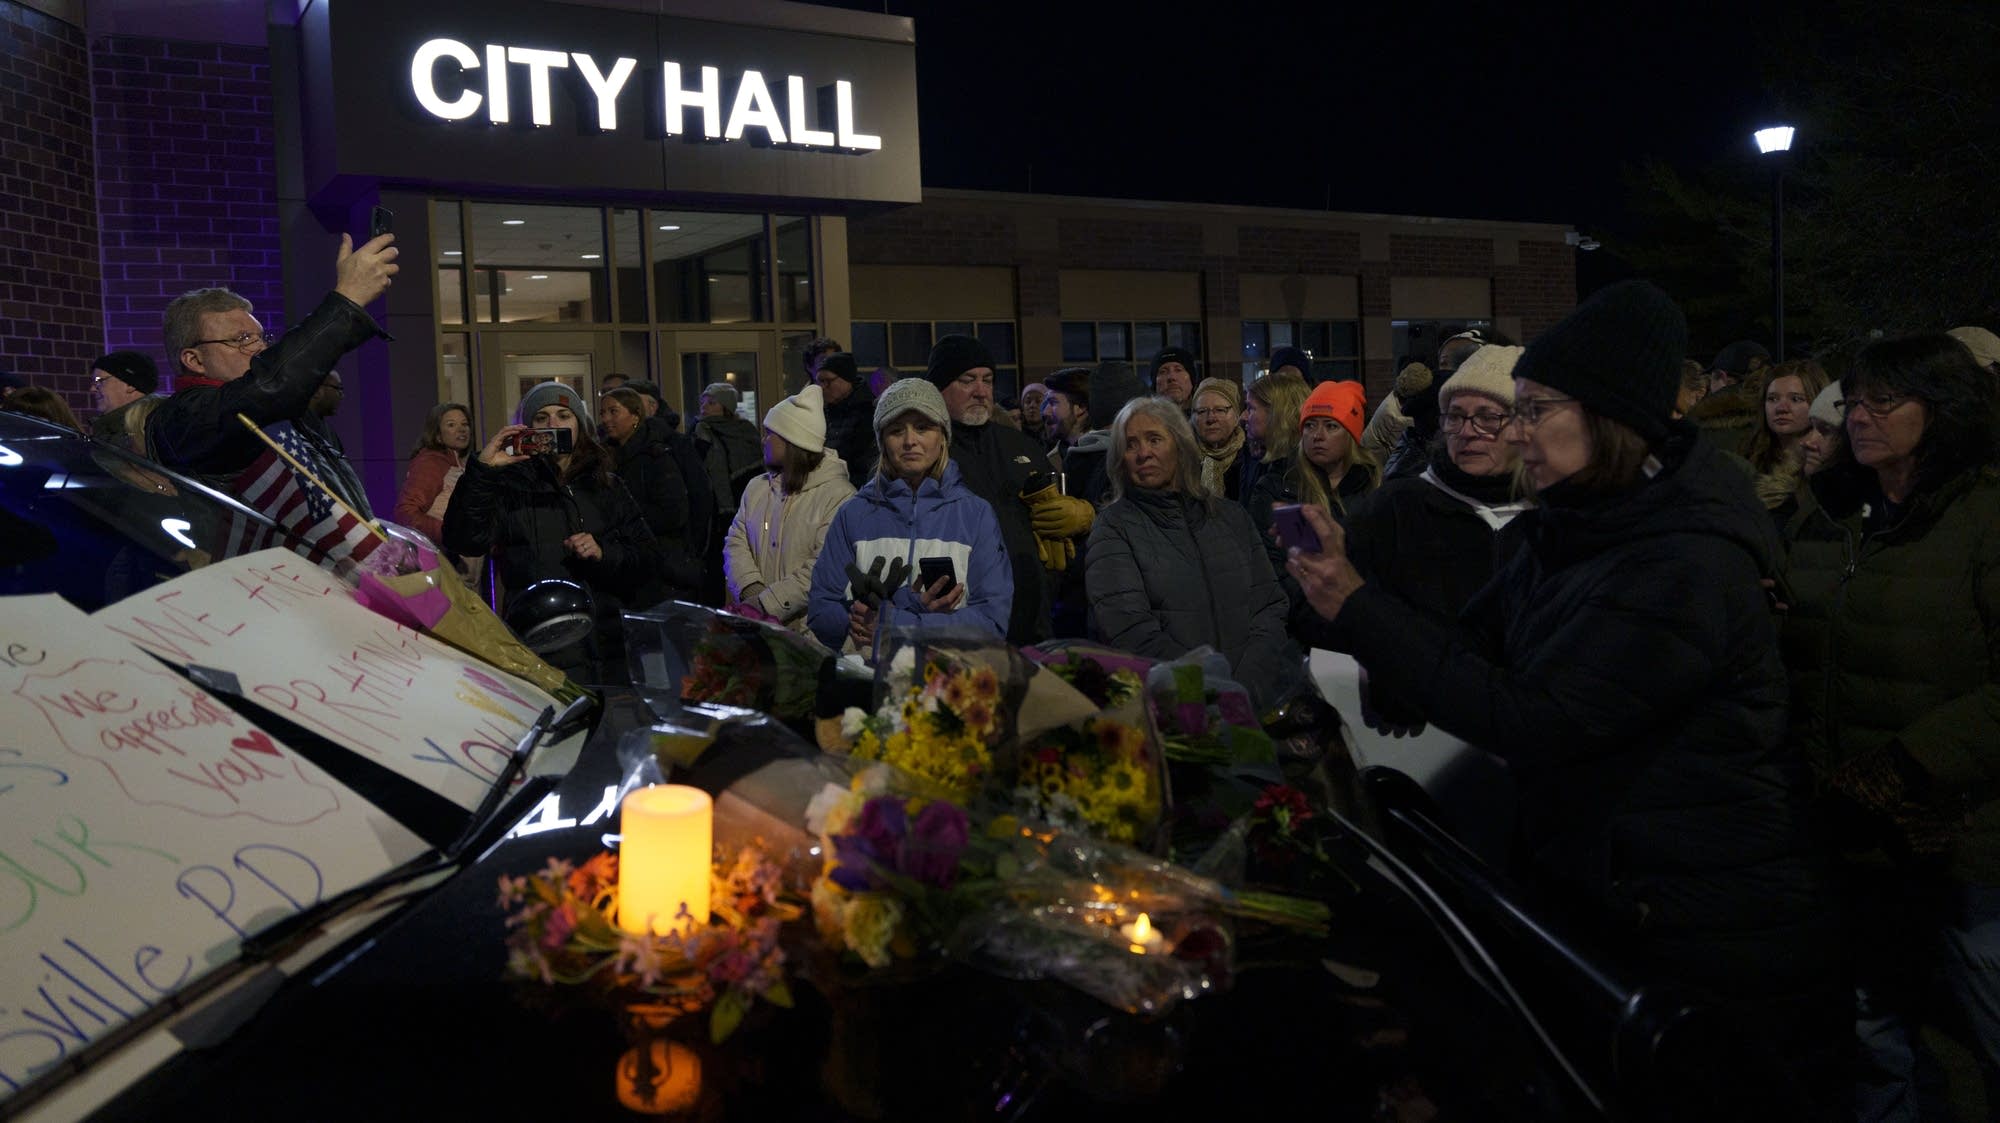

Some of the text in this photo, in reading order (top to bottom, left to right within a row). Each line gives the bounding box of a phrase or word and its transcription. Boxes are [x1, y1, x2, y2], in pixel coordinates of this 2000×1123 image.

[411, 38, 882, 150] CITY HALL
[103, 590, 246, 661] WE
[232, 563, 332, 614] ARE
[176, 842, 323, 939] PD
